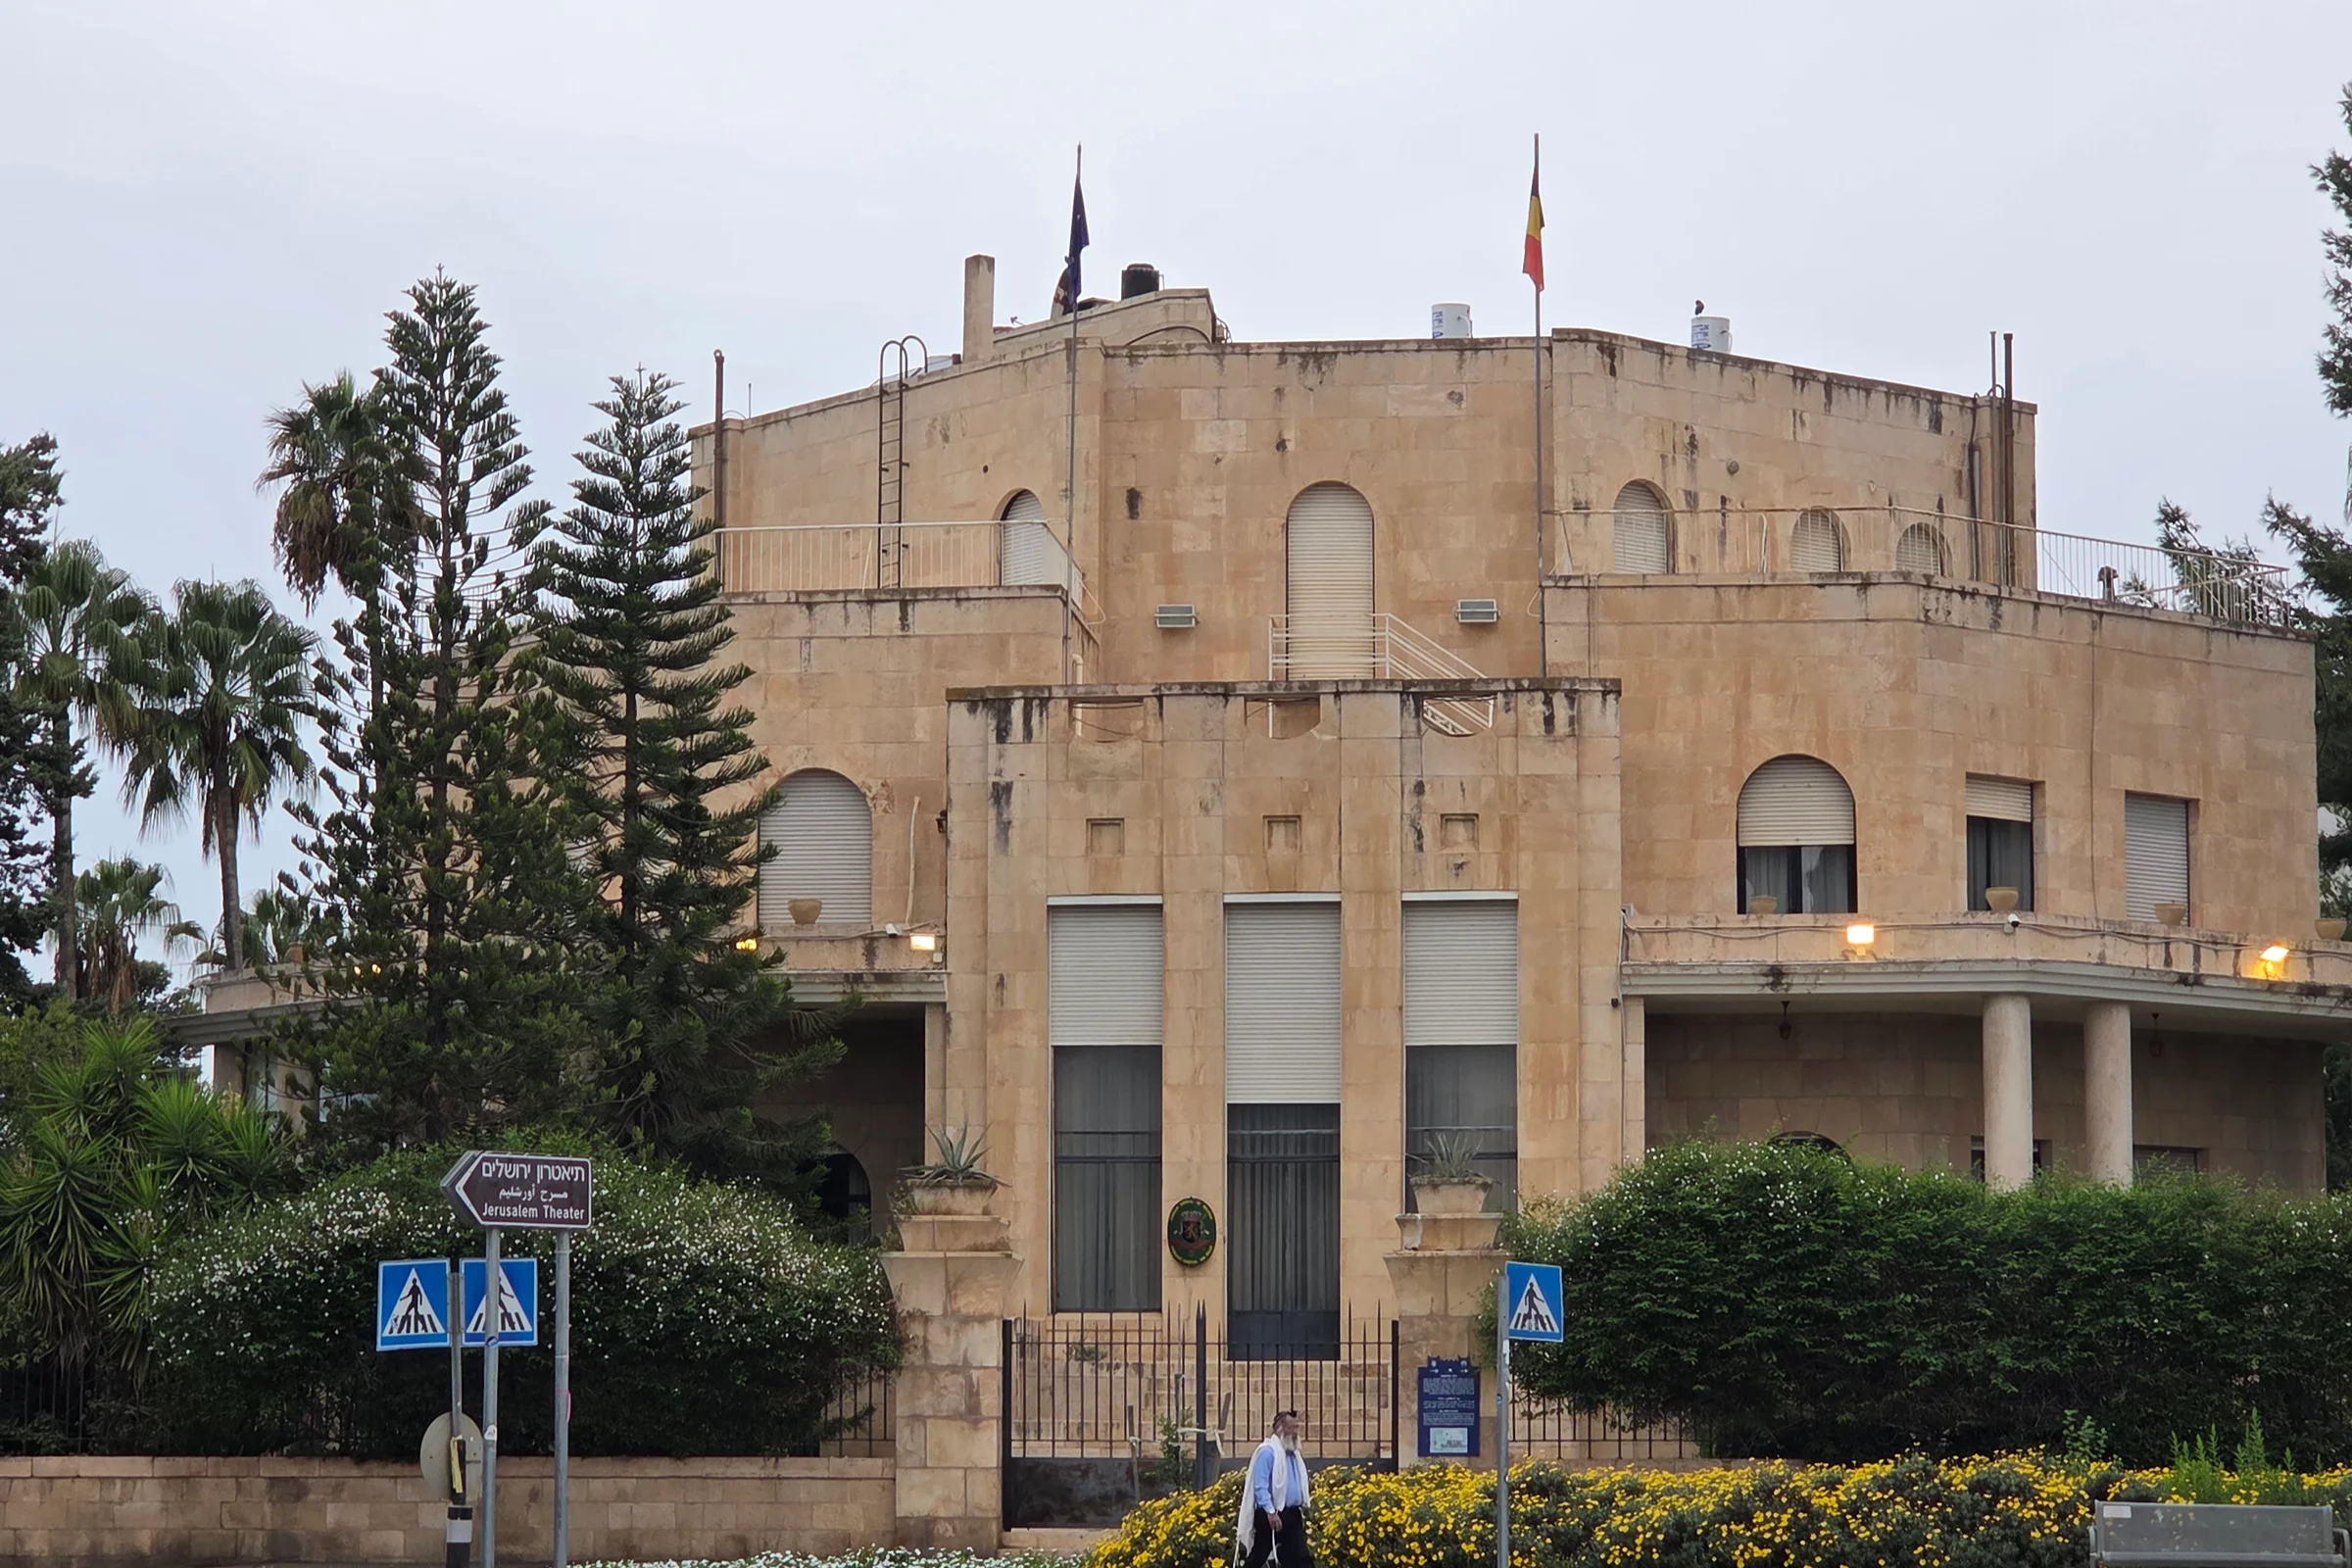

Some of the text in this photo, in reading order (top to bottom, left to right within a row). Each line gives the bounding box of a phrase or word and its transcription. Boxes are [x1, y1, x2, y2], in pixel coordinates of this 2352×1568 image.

[482, 1158, 585, 1184] תיאטרון ירושלים
[499, 1184, 568, 1201] مسرح أورشليم
[482, 1202, 585, 1220] Jerusalem Theater
